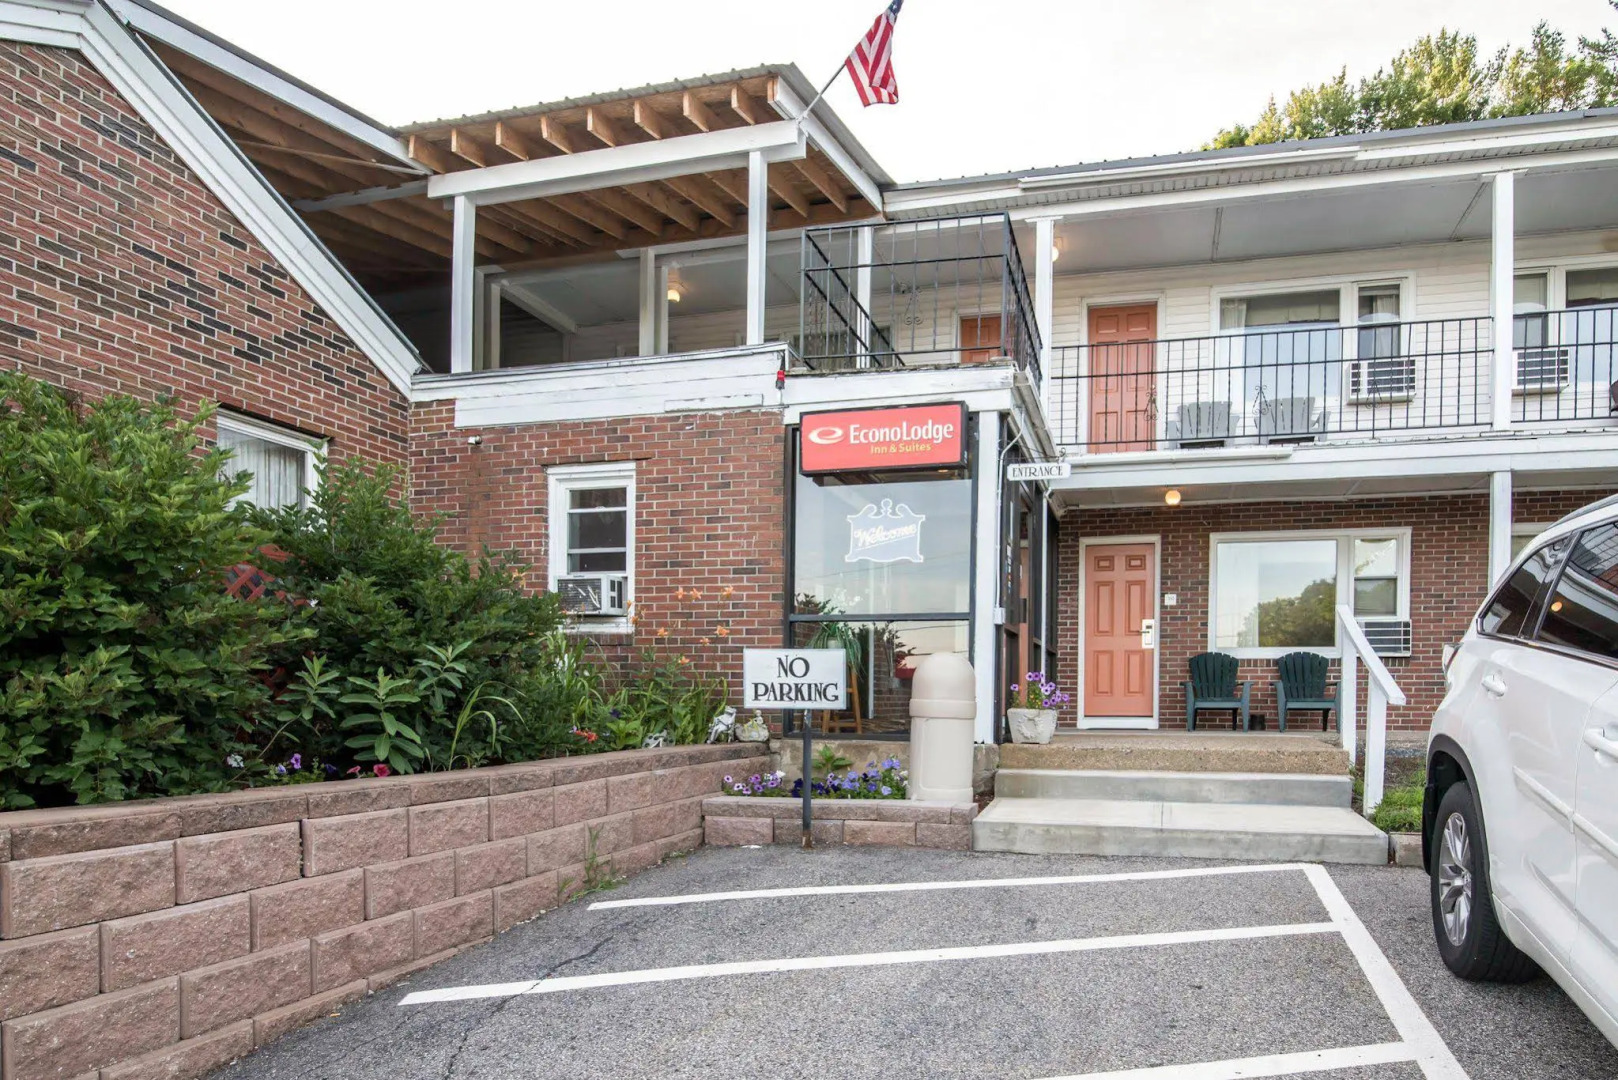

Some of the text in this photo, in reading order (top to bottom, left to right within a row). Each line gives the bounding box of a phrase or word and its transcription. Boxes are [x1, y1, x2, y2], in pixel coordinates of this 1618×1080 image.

[849, 419, 954, 444] EconoLodge
[870, 442, 932, 455] Inn & Suites
[1012, 465, 1063, 478] ENTRANCE
[853, 523, 917, 547] Welcome
[776, 655, 810, 678] NO
[751, 682, 839, 702] PARKING
